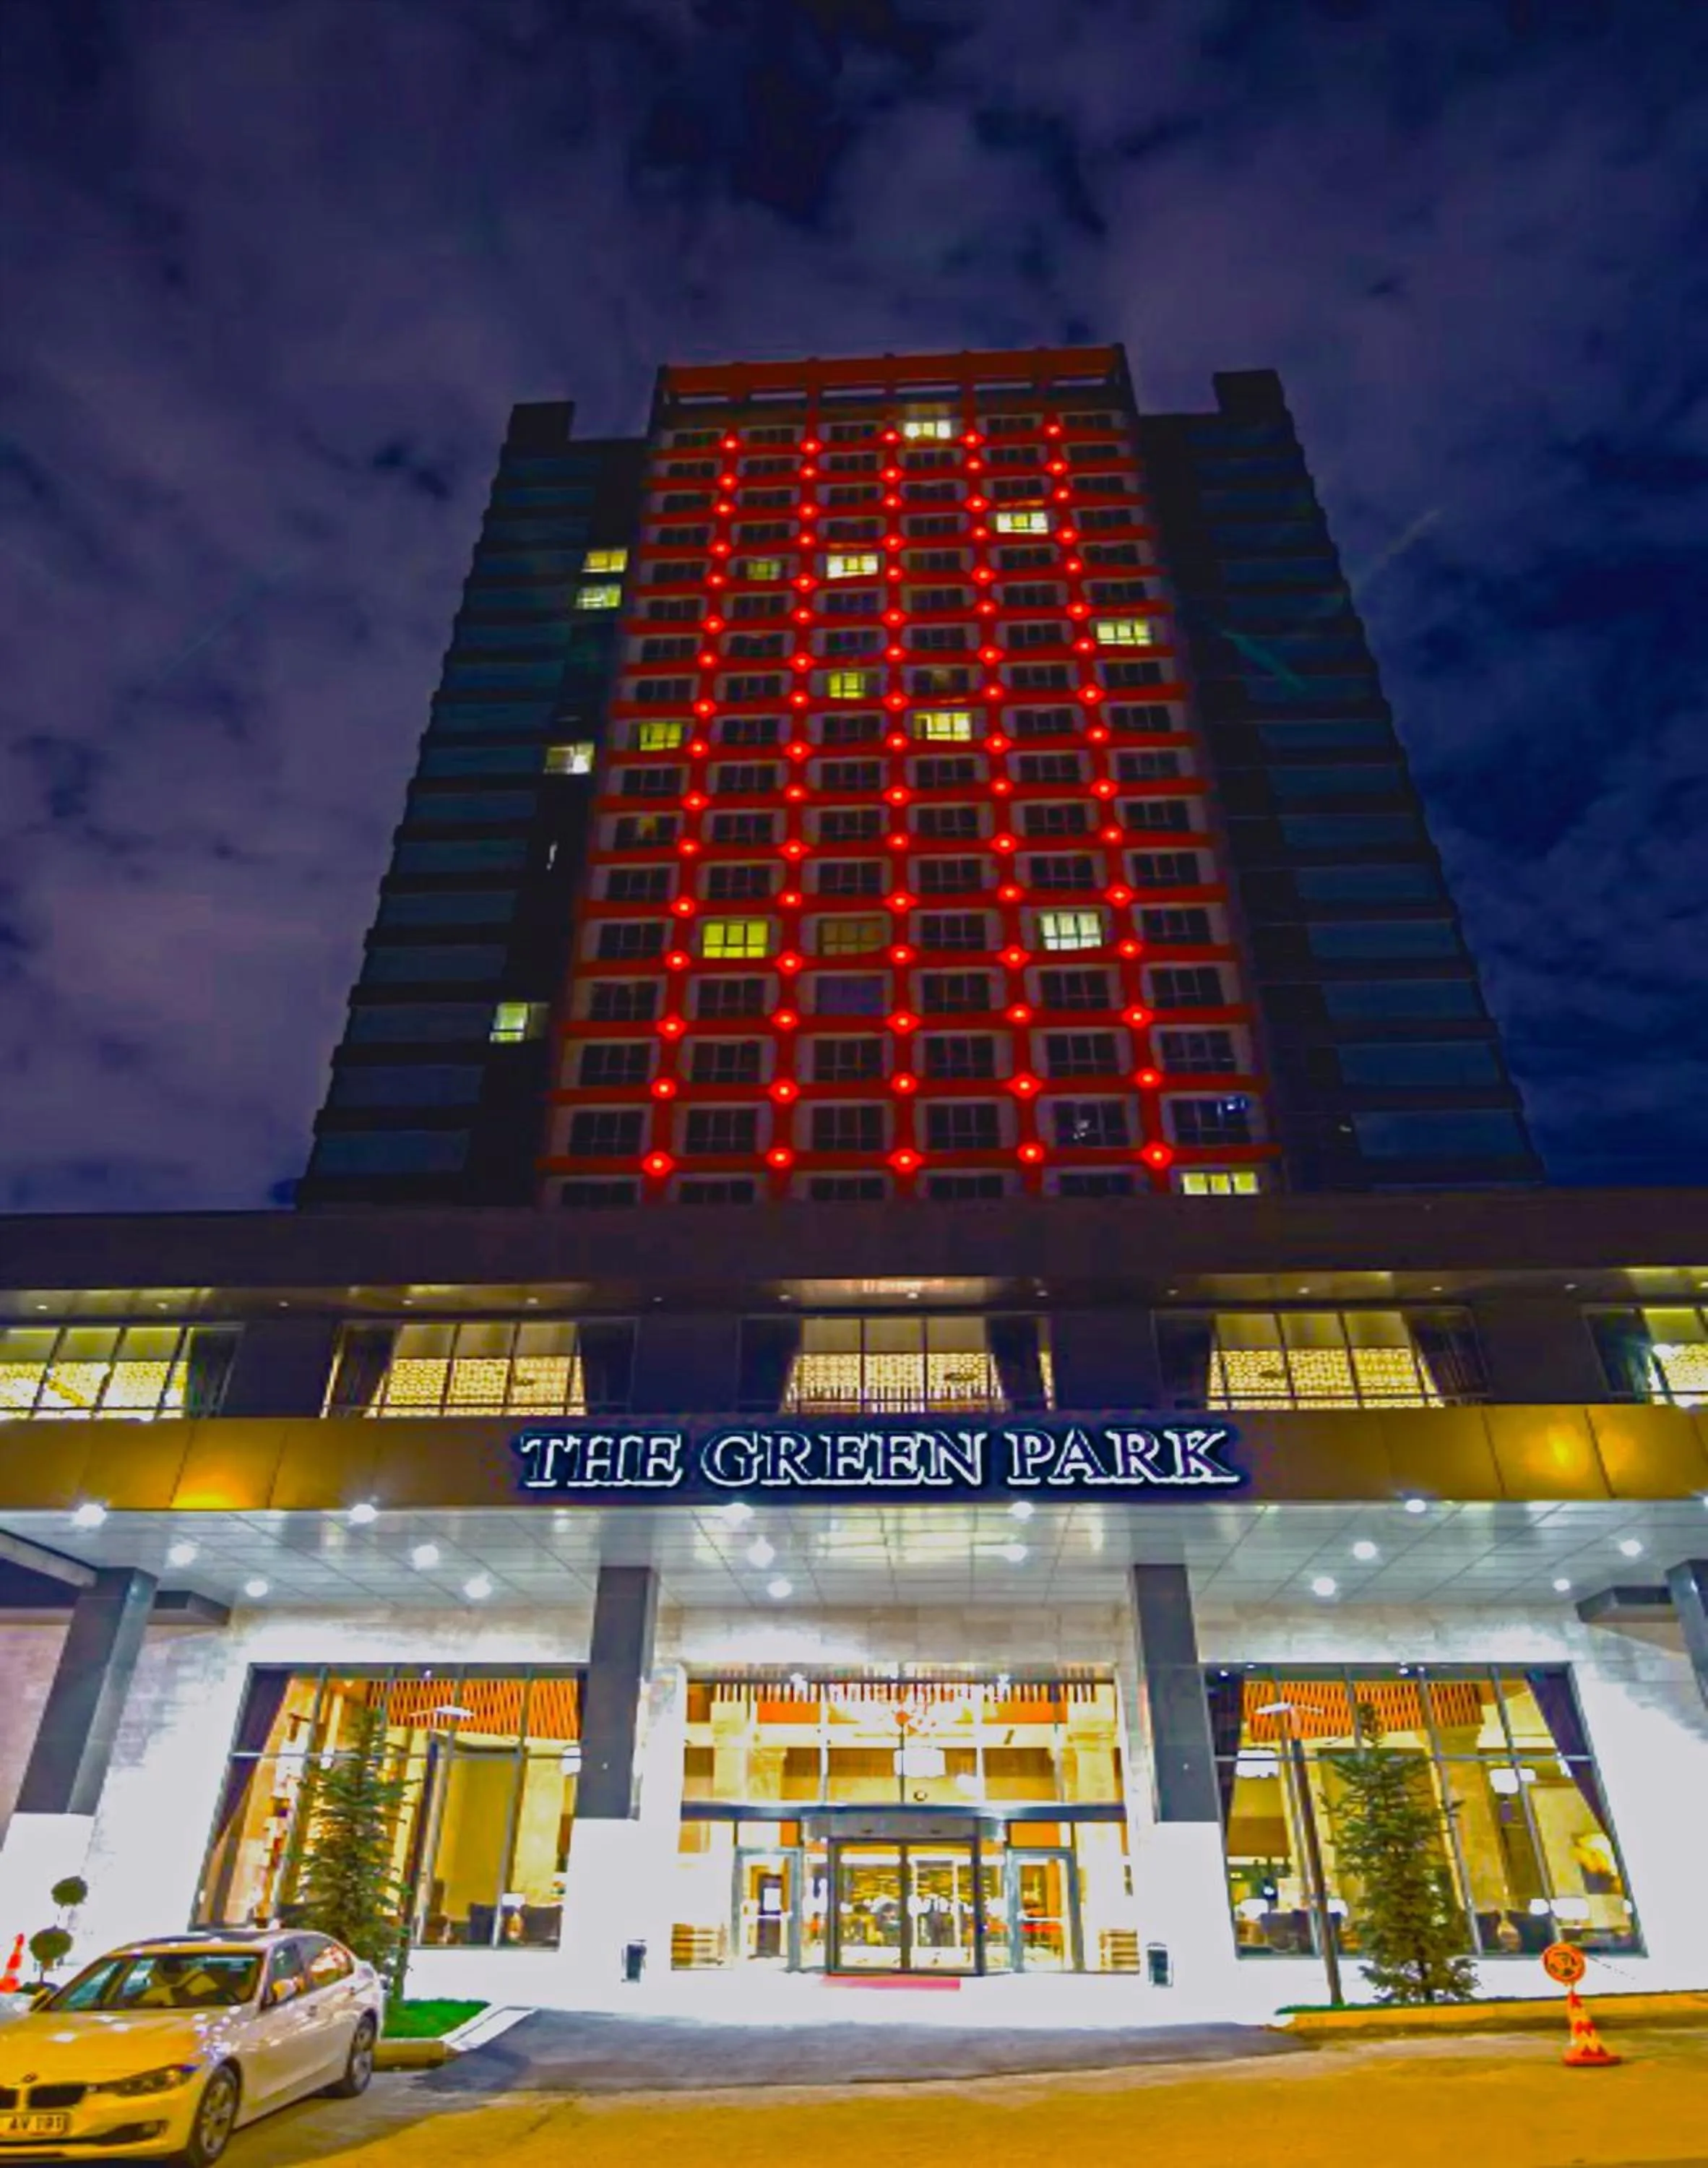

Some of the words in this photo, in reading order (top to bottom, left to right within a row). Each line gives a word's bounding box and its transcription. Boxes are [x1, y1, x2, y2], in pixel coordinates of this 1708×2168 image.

[519, 1432, 684, 1487] THE
[699, 1431, 988, 1487] GREEN
[1004, 1428, 1241, 1485] PARK
